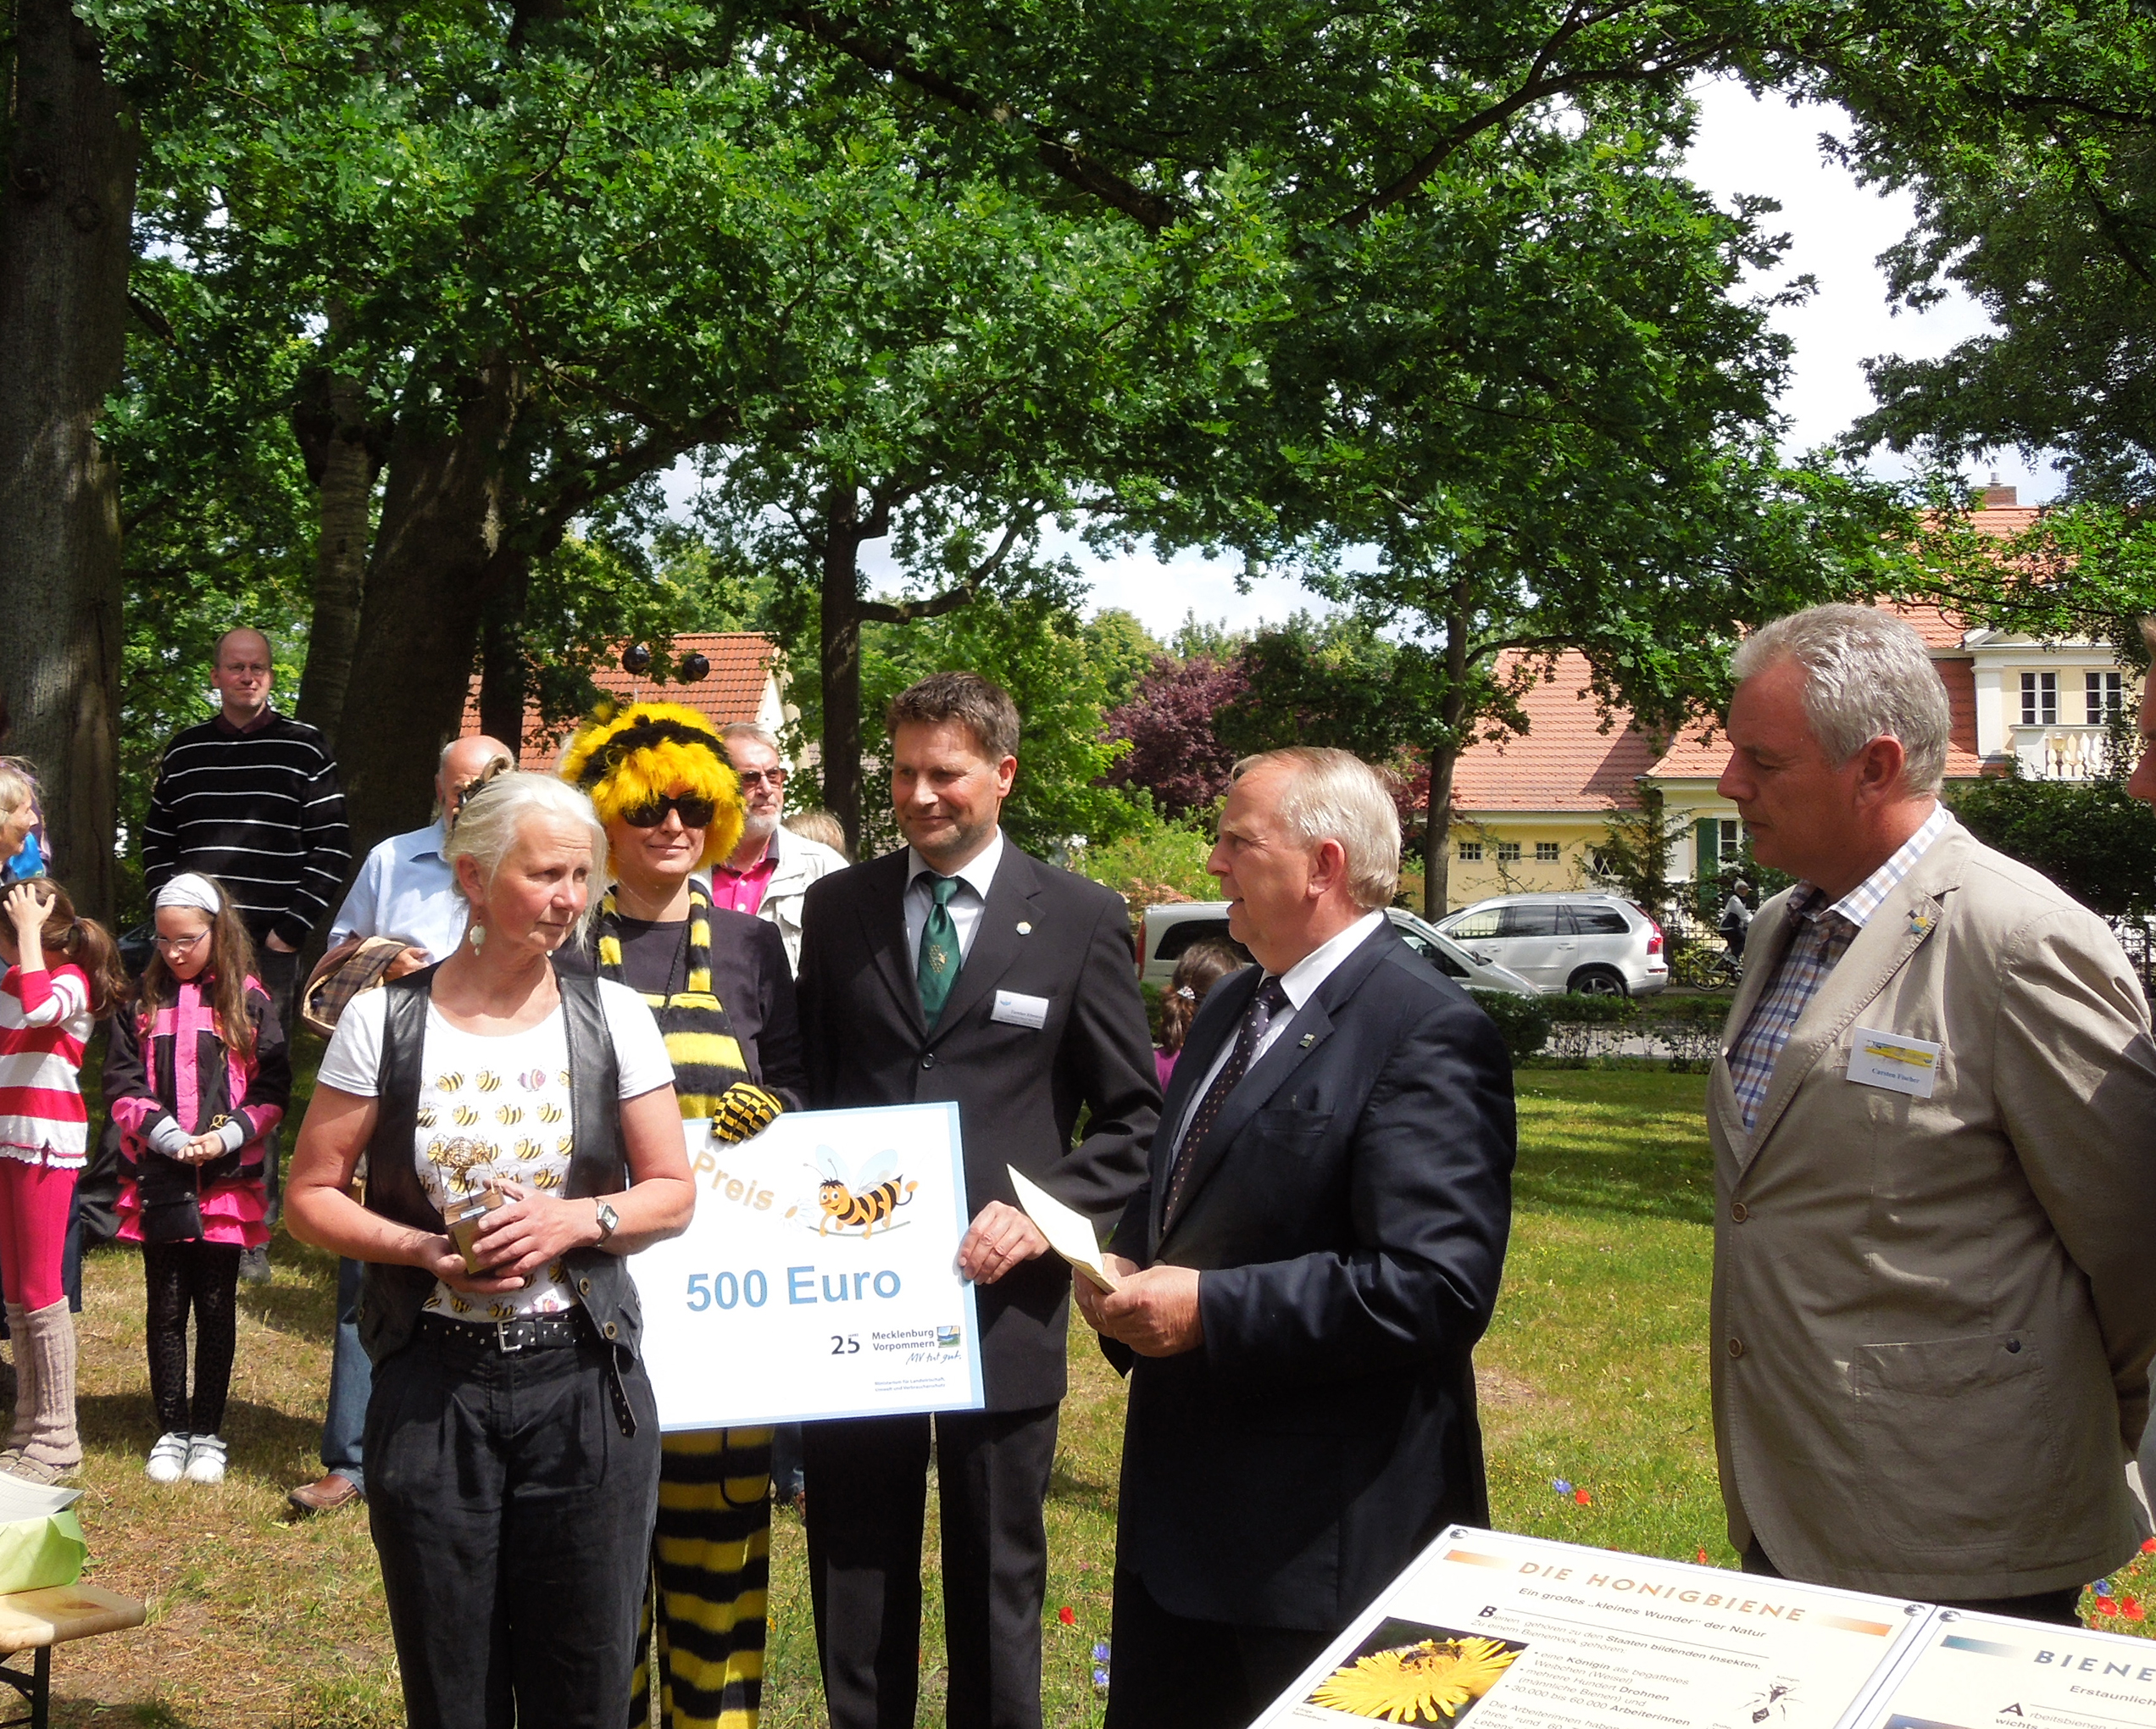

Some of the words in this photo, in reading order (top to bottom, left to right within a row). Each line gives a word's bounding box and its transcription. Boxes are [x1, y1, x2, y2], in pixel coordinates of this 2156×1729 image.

[692, 1149, 775, 1211] Preis
[686, 1269, 767, 1312] 500
[787, 1265, 901, 1305] Euro
[831, 1335, 860, 1355] 25
[872, 1329, 934, 1340] Mecklenburg
[873, 1340, 935, 1352] Vorpommern
[1518, 1562, 1573, 1581] DIE
[1586, 1573, 1806, 1622] HONIGBIENE
[1519, 1587, 1539, 1597] Ein
[1542, 1592, 1586, 1606] großes
[1703, 1620, 1726, 1631] der
[1729, 1625, 1767, 1637] Natur
[1470, 1619, 1485, 1627] Zu
[1487, 1622, 1519, 1634] einem
[1521, 1628, 1577, 1645] Bienenvolk
[1524, 1621, 1568, 1634] gehören
[1583, 1631, 1603, 1640] den
[1606, 1635, 1648, 1648] Staaten
[1650, 1643, 1707, 1660] bildenden
[1709, 1654, 1761, 1670] Insekten.
[1525, 1669, 1570, 1682] mehrere
[1573, 1676, 1617, 1692] Hundert
[1619, 1686, 1670, 1702] Drohnen
[1534, 1660, 1586, 1676] Weibchen
[1588, 1671, 1633, 1685] (Weisel)
[1541, 1653, 1564, 1661] eine
[1566, 1656, 1610, 1671] Königin
[1613, 1665, 1630, 1675] als
[1631, 1669, 1690, 1686] begattetes
[1511, 1685, 1549, 1698] 30.000
[1550, 1693, 1567, 1702] bis
[1570, 1696, 1608, 1710] 60.000
[1609, 1704, 1691, 1726] Arbeiterinnen
[1518, 1676, 1577, 1694] (männliche
[1580, 1687, 1622, 1704] Bienen)
[1624, 1698, 1647, 1707] und
[1481, 1709, 1508, 1720] ihres
[1514, 1716, 1542, 1726] rund
[1489, 1699, 1507, 1709] Die
[1509, 1704, 1581, 1725] Arbeiterinnen
